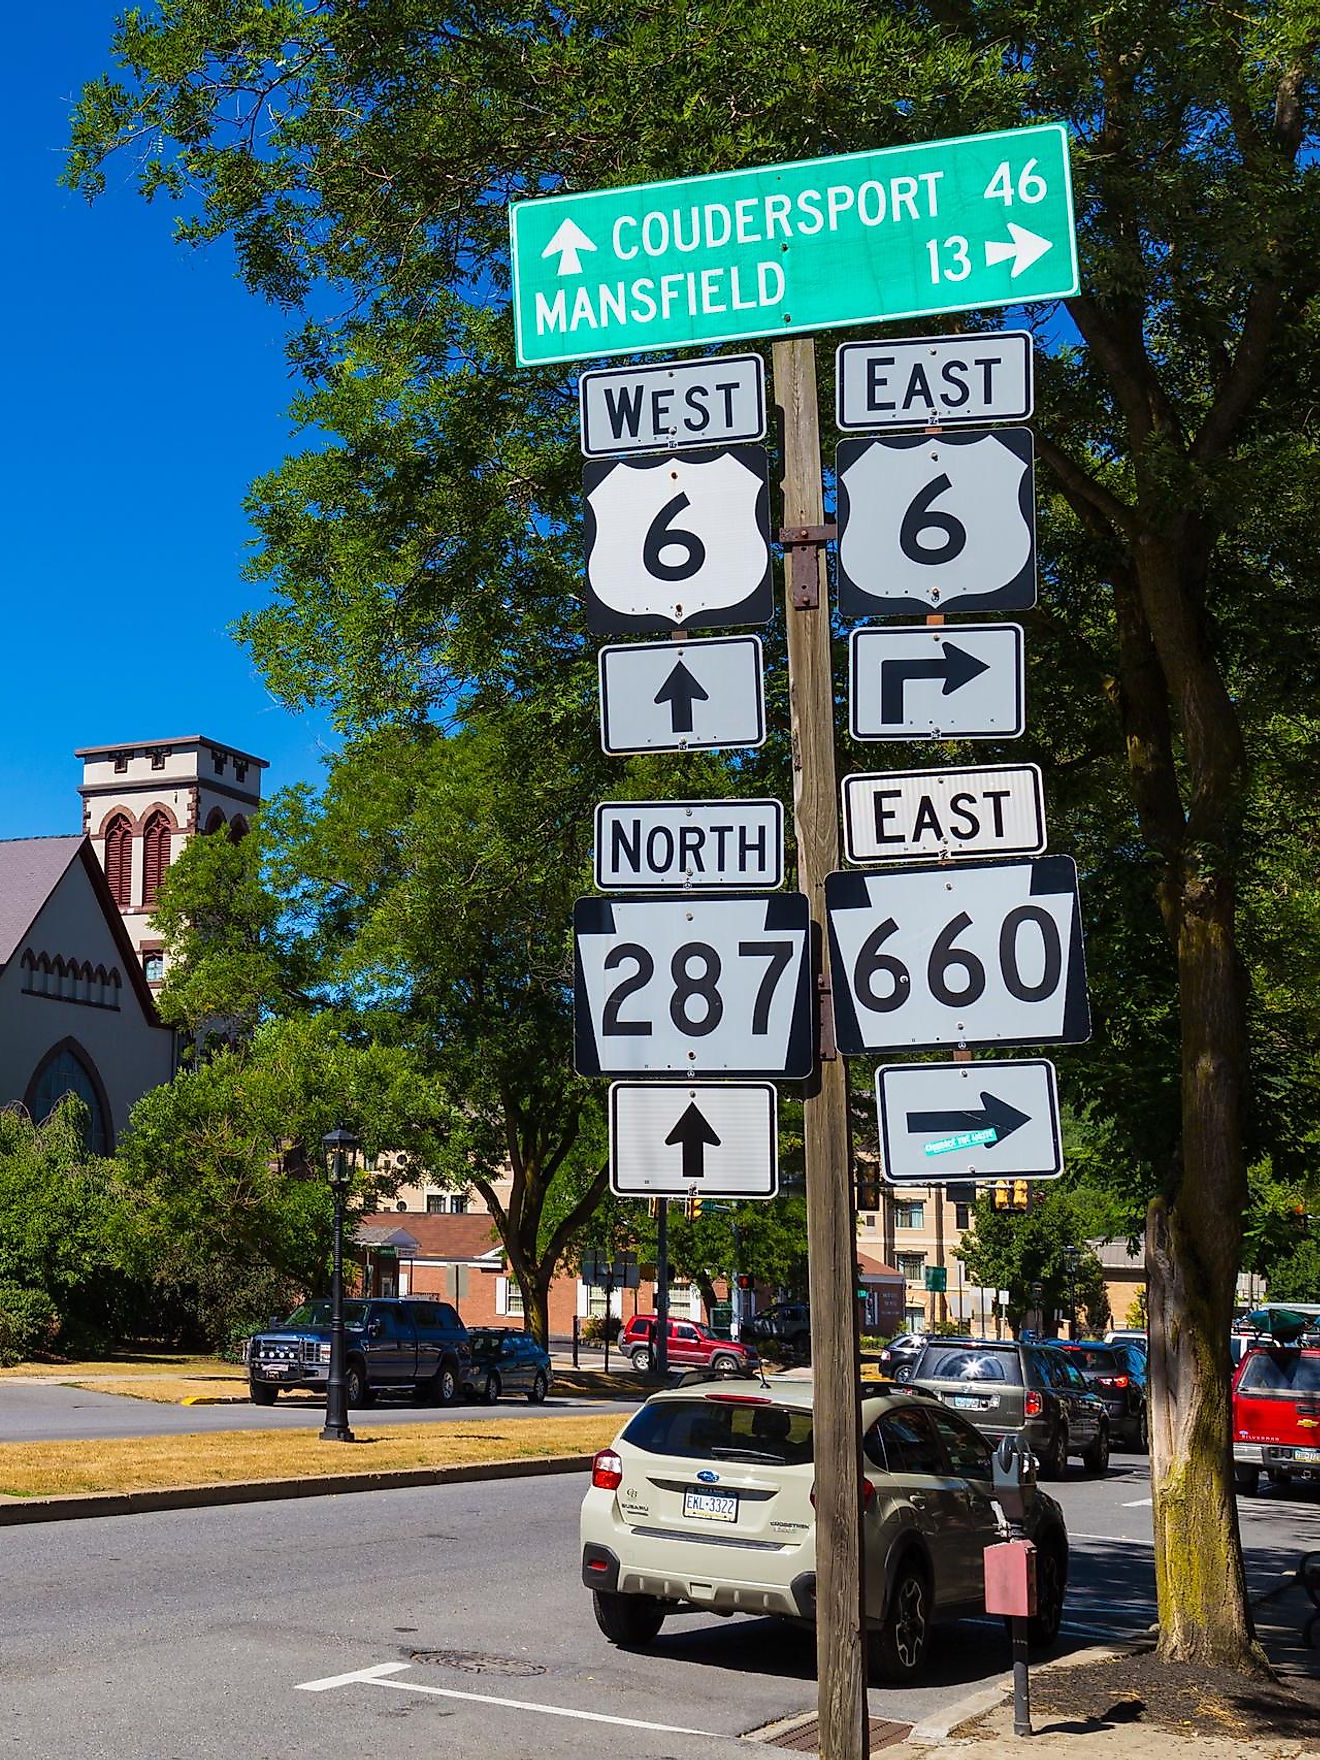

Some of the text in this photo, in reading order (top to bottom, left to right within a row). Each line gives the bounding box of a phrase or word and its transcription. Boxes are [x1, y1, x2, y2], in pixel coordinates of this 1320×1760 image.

[612, 158, 1048, 261] COUDERSPORT 46
[535, 235, 972, 335] MANSFIELD 13
[603, 382, 741, 439] WEST
[865, 357, 1002, 411] EAST
[643, 491, 705, 581] 6
[900, 472, 967, 565] 6
[611, 819, 766, 873] NORTH
[873, 789, 1011, 844] EAST
[602, 941, 794, 1037] 287
[853, 904, 1061, 1013] 660
